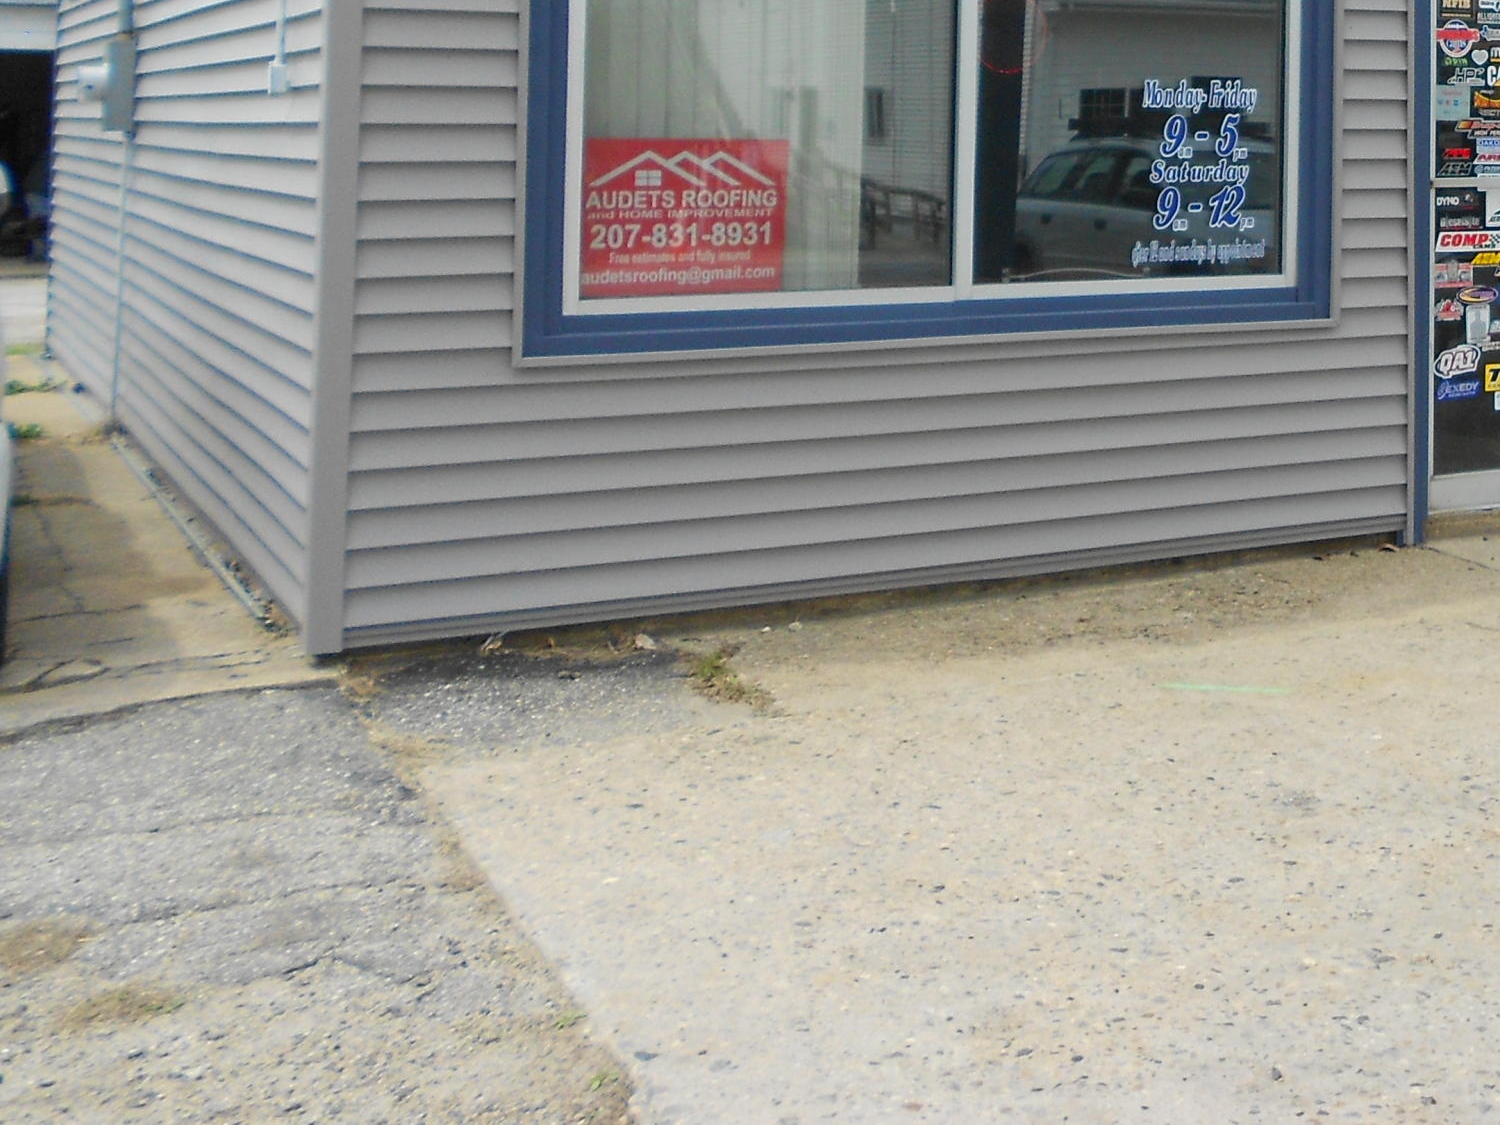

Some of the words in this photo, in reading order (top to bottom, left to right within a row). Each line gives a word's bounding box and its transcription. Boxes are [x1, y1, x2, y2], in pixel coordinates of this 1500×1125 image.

[1142, 78, 1257, 114] Monday-Friday
[1149, 159, 1249, 186] Saturday
[585, 190, 675, 209] AUDETS
[681, 189, 778, 208] ROOFING
[1436, 196, 1460, 206] DYNO
[588, 210, 614, 220] and
[619, 209, 663, 219] HOME
[667, 207, 774, 219] IMPROVEMENT
[590, 221, 771, 250] 207-831-8931
[1440, 233, 1489, 247] COMP
[609, 252, 629, 264] Free
[631, 251, 675, 264] estimates
[678, 251, 694, 262] and
[696, 250, 715, 264] fully
[582, 265, 776, 286] audetsroofing@gmail.com
[1440, 350, 1475, 376] QA1
[1446, 381, 1479, 393] EXEDY
